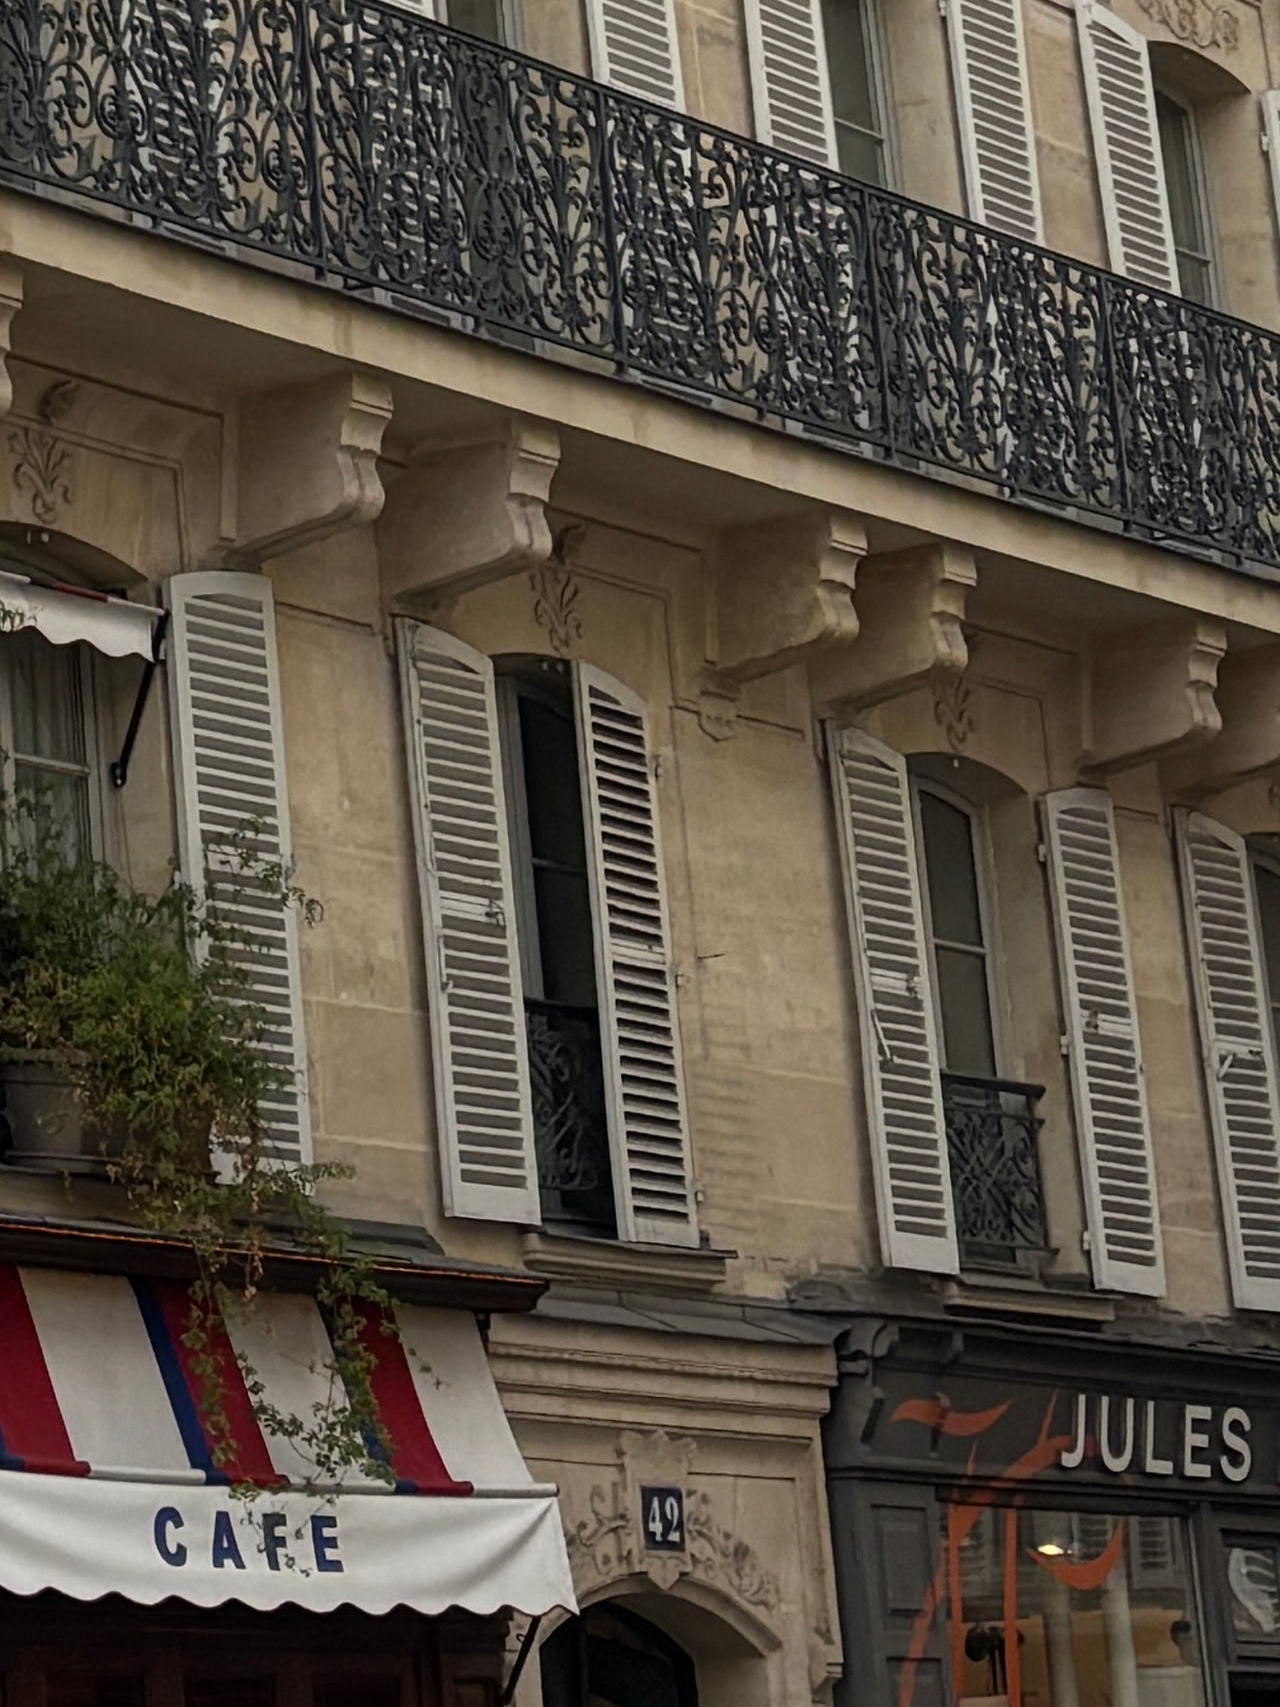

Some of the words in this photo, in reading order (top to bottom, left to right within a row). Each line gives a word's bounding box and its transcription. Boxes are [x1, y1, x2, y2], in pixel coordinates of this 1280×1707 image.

[1061, 1394, 1252, 1481] JULES
[154, 1506, 344, 1572] CAFE
[648, 1496, 680, 1542] 42
